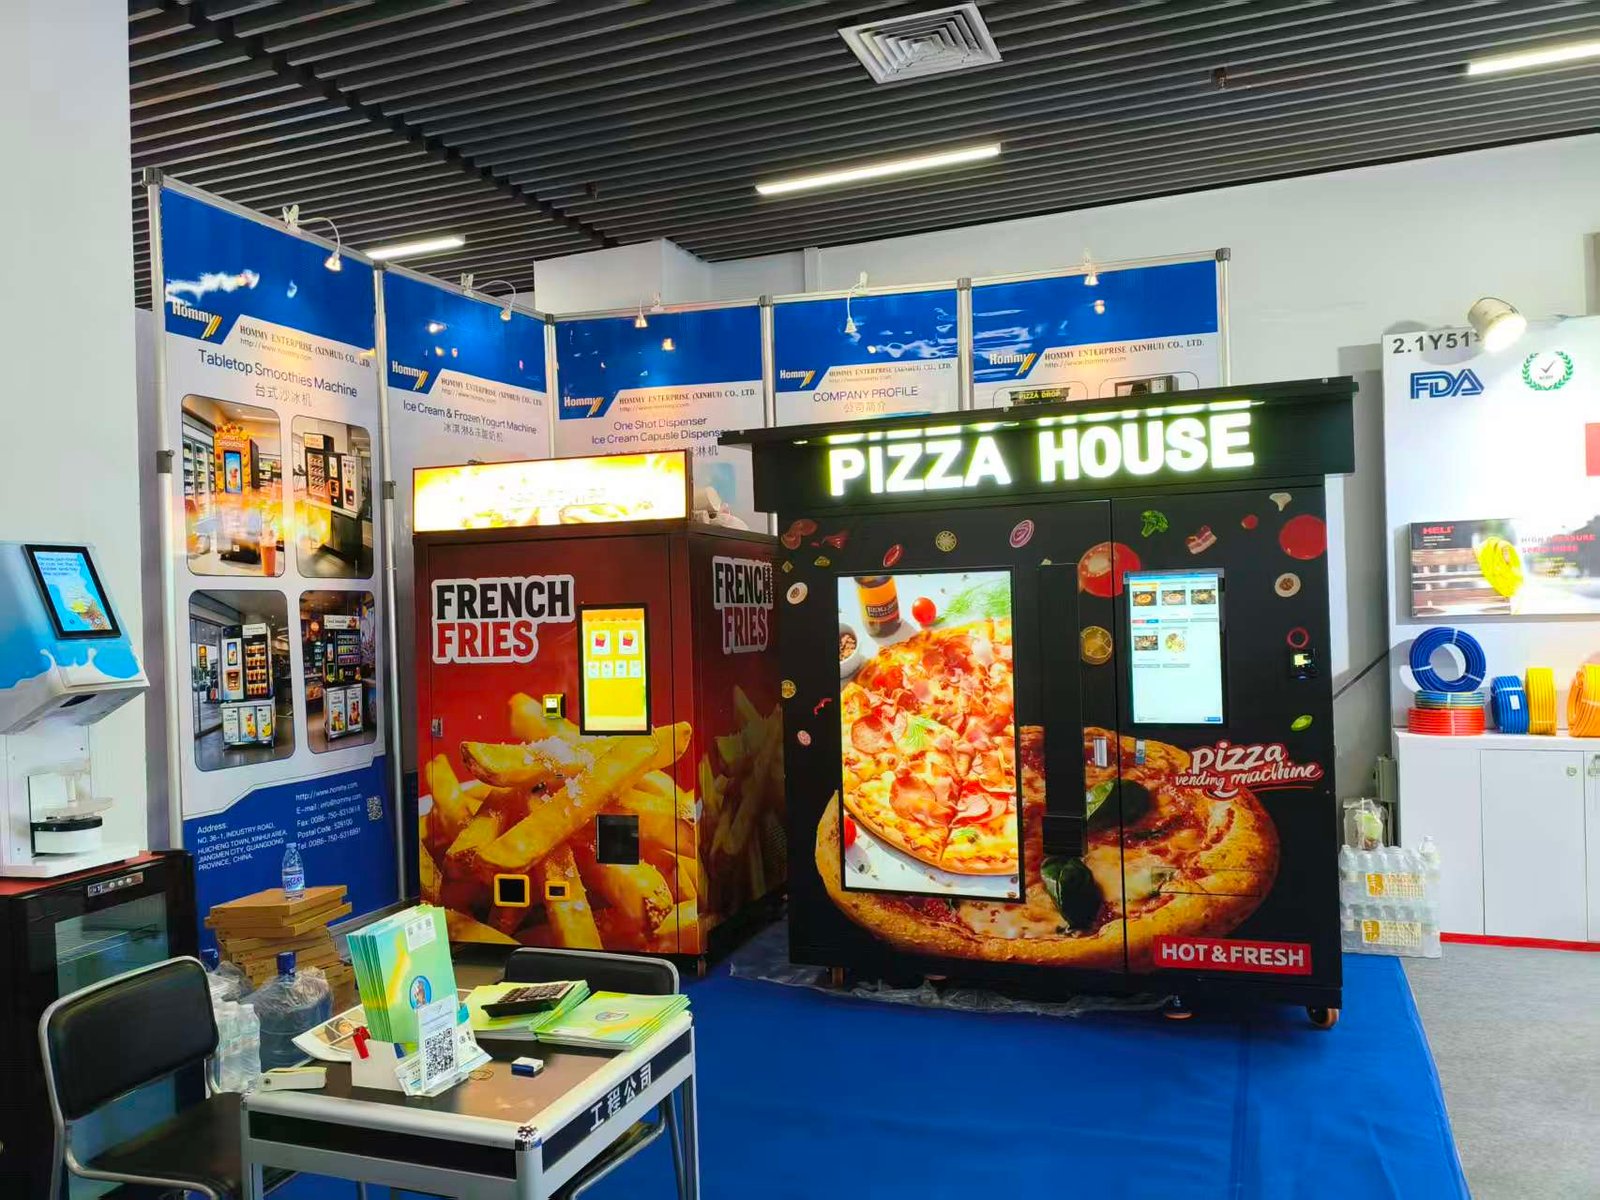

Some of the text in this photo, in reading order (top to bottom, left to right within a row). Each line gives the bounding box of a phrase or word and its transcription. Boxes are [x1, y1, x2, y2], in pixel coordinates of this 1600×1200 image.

[173, 300, 222, 339] Hommy
[240, 325, 268, 341] HOMMY
[271, 334, 313, 354] ENTERPRISE
[1044, 349, 1074, 361] HOMMY
[1078, 346, 1127, 358] ENTERPRISE
[1130, 342, 1165, 354] (XINHUI)
[1186, 338, 1204, 348] LTD.
[198, 348, 358, 398] Tabletop Smoothies Machine
[392, 360, 428, 391] Hommy
[989, 352, 1037, 376] Hommy
[780, 369, 816, 389] Hommy
[1410, 369, 1485, 399] FDA
[255, 382, 313, 407] 台式沙冰机
[619, 395, 646, 405] HOMMY
[648, 392, 690, 403] ENTERPRISE
[691, 390, 723, 400] (XINHUI)
[741, 388, 756, 397] LTD.
[813, 385, 919, 403] COMPANY PROFILE
[843, 400, 886, 413] 公司简介
[1018, 389, 1040, 400] PIZZA
[403, 399, 537, 435] Ice Cream & Frozen Yogurt Machine
[563, 396, 604, 418] Hommy
[613, 417, 708, 431] One Shot Dispenser
[592, 435, 606, 445] Ice
[606, 433, 639, 444] Cream
[828, 411, 1256, 497] PIZZA HOUSE
[715, 560, 773, 605] FRENCH
[436, 579, 571, 621] FRENCH
[436, 620, 535, 659] FRIES
[723, 606, 769, 648] FRIES
[1190, 741, 1287, 775] pizza
[1175, 762, 1320, 789] vending machine
[197, 836, 208, 845] NO.
[226, 826, 256, 838] INDUSTRY
[198, 842, 230, 855] HUICHENG
[251, 833, 271, 842] XINHUI
[246, 837, 284, 852] GUANGDONG
[297, 830, 317, 839] Postal
[1161, 942, 1305, 967] HOT & FRESH
[590, 1062, 652, 1132] 工程公司
